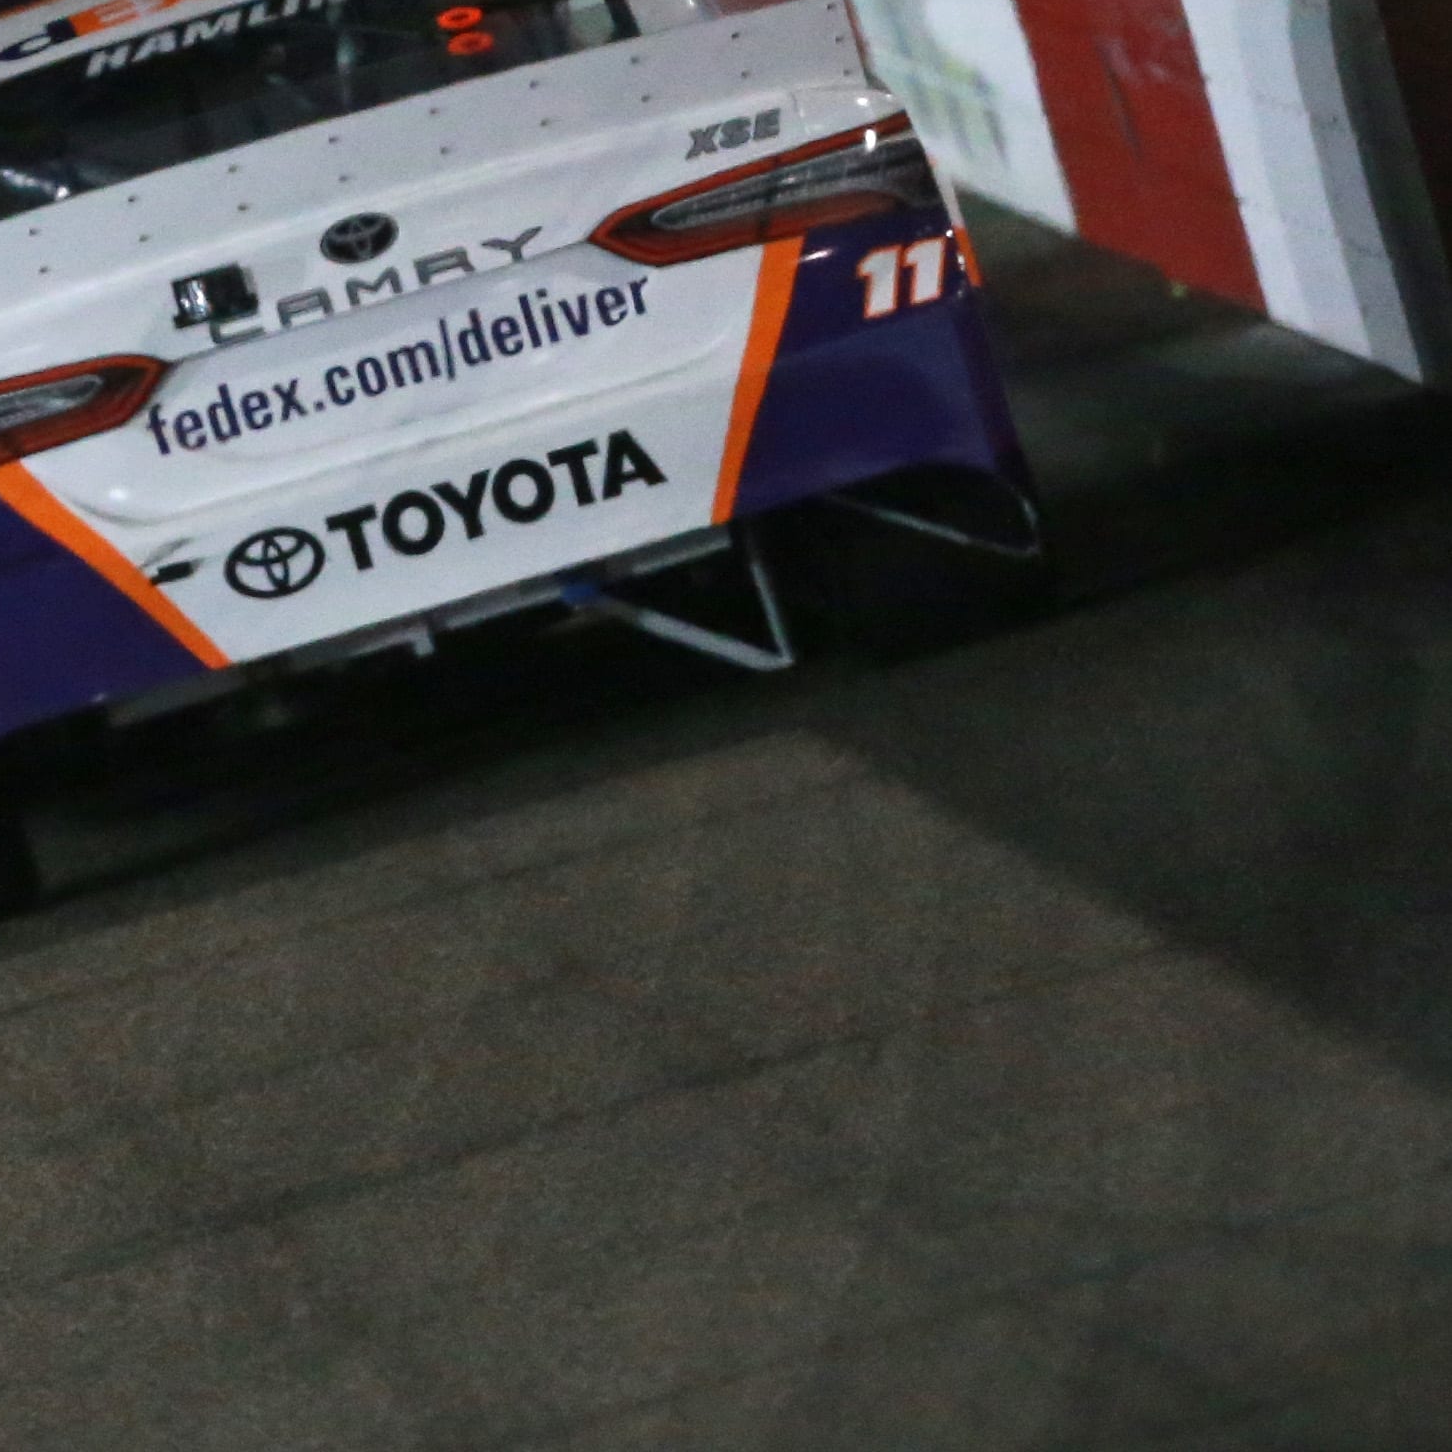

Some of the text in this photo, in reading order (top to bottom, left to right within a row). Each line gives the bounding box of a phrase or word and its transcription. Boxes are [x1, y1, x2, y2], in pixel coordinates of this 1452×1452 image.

[686, 108, 782, 161] XSE
[856, 237, 946, 319] 11
[145, 276, 649, 455] fedex.com/deliver
[325, 428, 669, 571] TOYOTA
